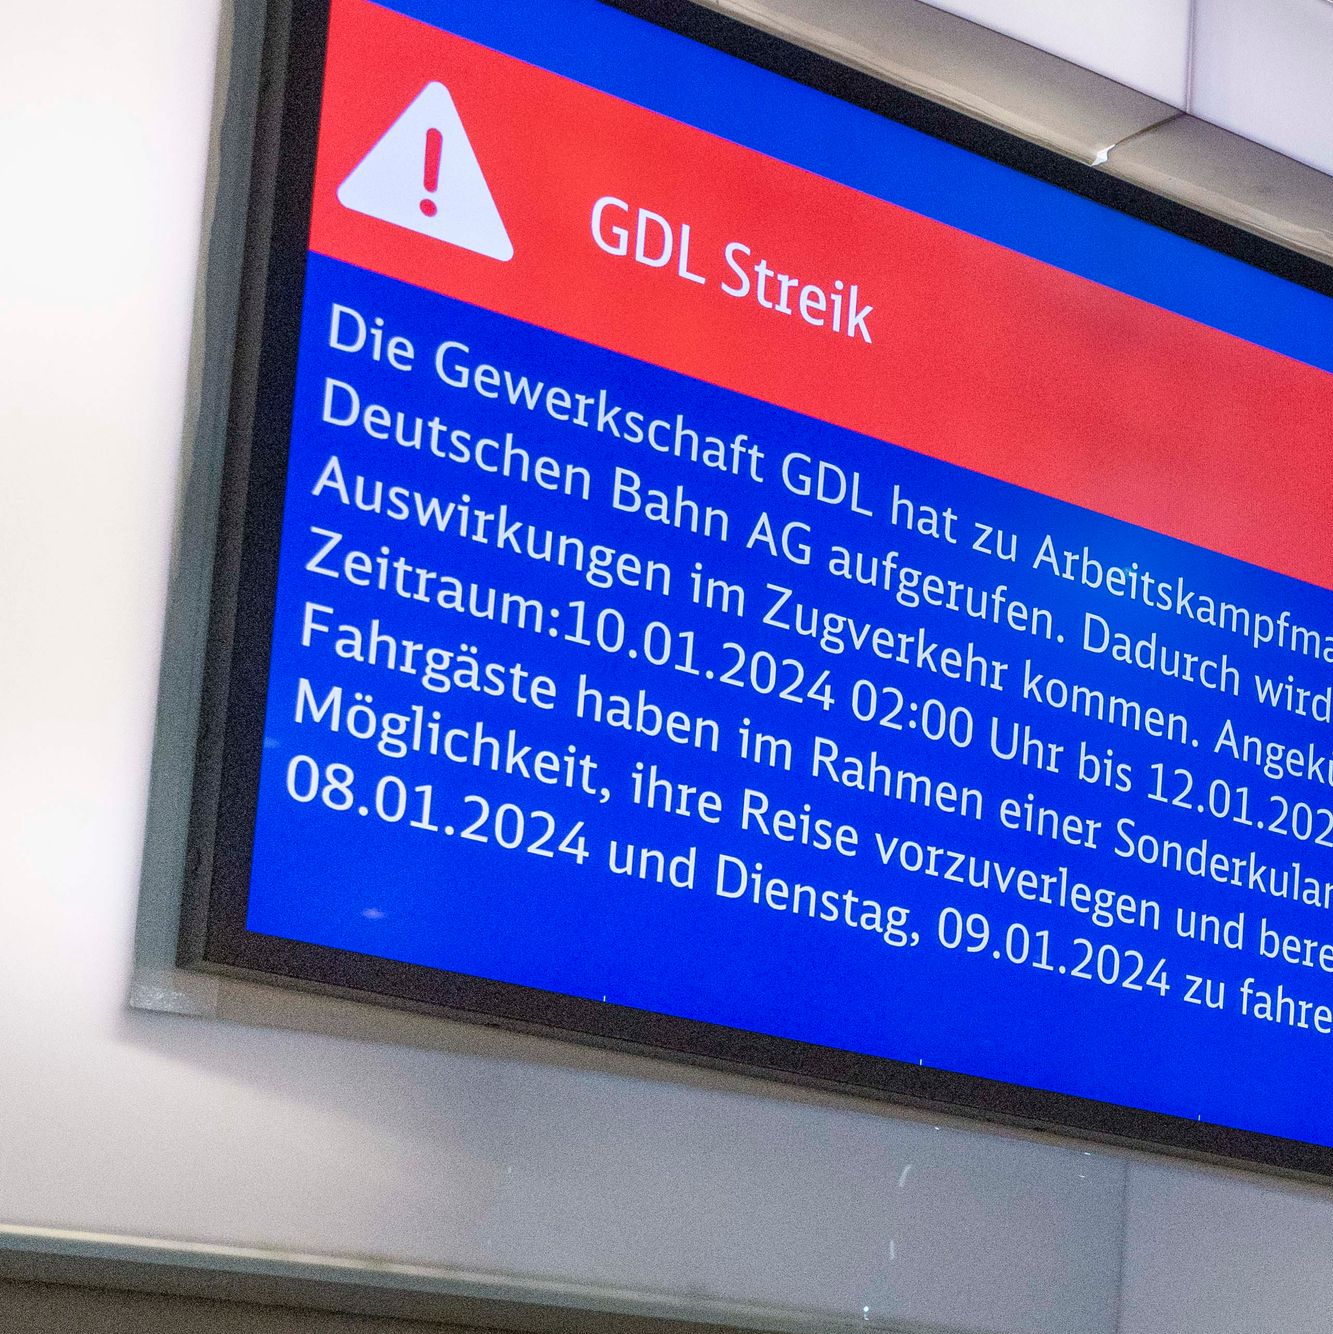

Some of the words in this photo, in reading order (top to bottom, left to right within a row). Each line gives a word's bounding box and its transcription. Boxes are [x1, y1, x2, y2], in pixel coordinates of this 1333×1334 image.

[590, 195, 706, 285] GDL
[720, 241, 874, 344] Streik
[322, 377, 591, 500] Deutschen
[612, 466, 729, 542] Bahn
[746, 512, 811, 565] AG
[828, 545, 1064, 643] aufgerufen.
[1083, 612, 1240, 696] Dadurch
[1254, 675, 1332, 723] wird
[329, 303, 415, 372] Die
[435, 340, 765, 483] Gewerkschaft
[781, 452, 873, 517] GDL
[891, 484, 958, 544] hat
[972, 522, 1017, 562] zu
[301, 601, 557, 710] Fahrgäste
[576, 674, 720, 752] haben
[738, 717, 792, 771] im
[812, 736, 983, 820] Rahmen
[999, 793, 1102, 849] einer
[305, 526, 835, 711] Zeitraum:10.01.2024
[851, 679, 974, 748] 02:00
[990, 716, 1064, 773] Uhr
[1078, 741, 1132, 792] bis
[311, 455, 671, 596] Auswirkungen
[690, 562, 745, 617] im
[762, 583, 1009, 691] Zugverkehr
[1023, 659, 1199, 748] kommen.
[286, 754, 590, 865] 08.01.2024
[608, 840, 697, 890] und
[716, 853, 920, 947] Dienstag,
[938, 906, 1170, 997] 09.01.2024
[1183, 974, 1225, 1009] zu
[294, 677, 611, 804] Möglichkeit,
[631, 761, 723, 824] ihre
[741, 788, 859, 857] Reise
[875, 833, 1160, 930] vorzuverlegen
[1176, 908, 1245, 950] und
